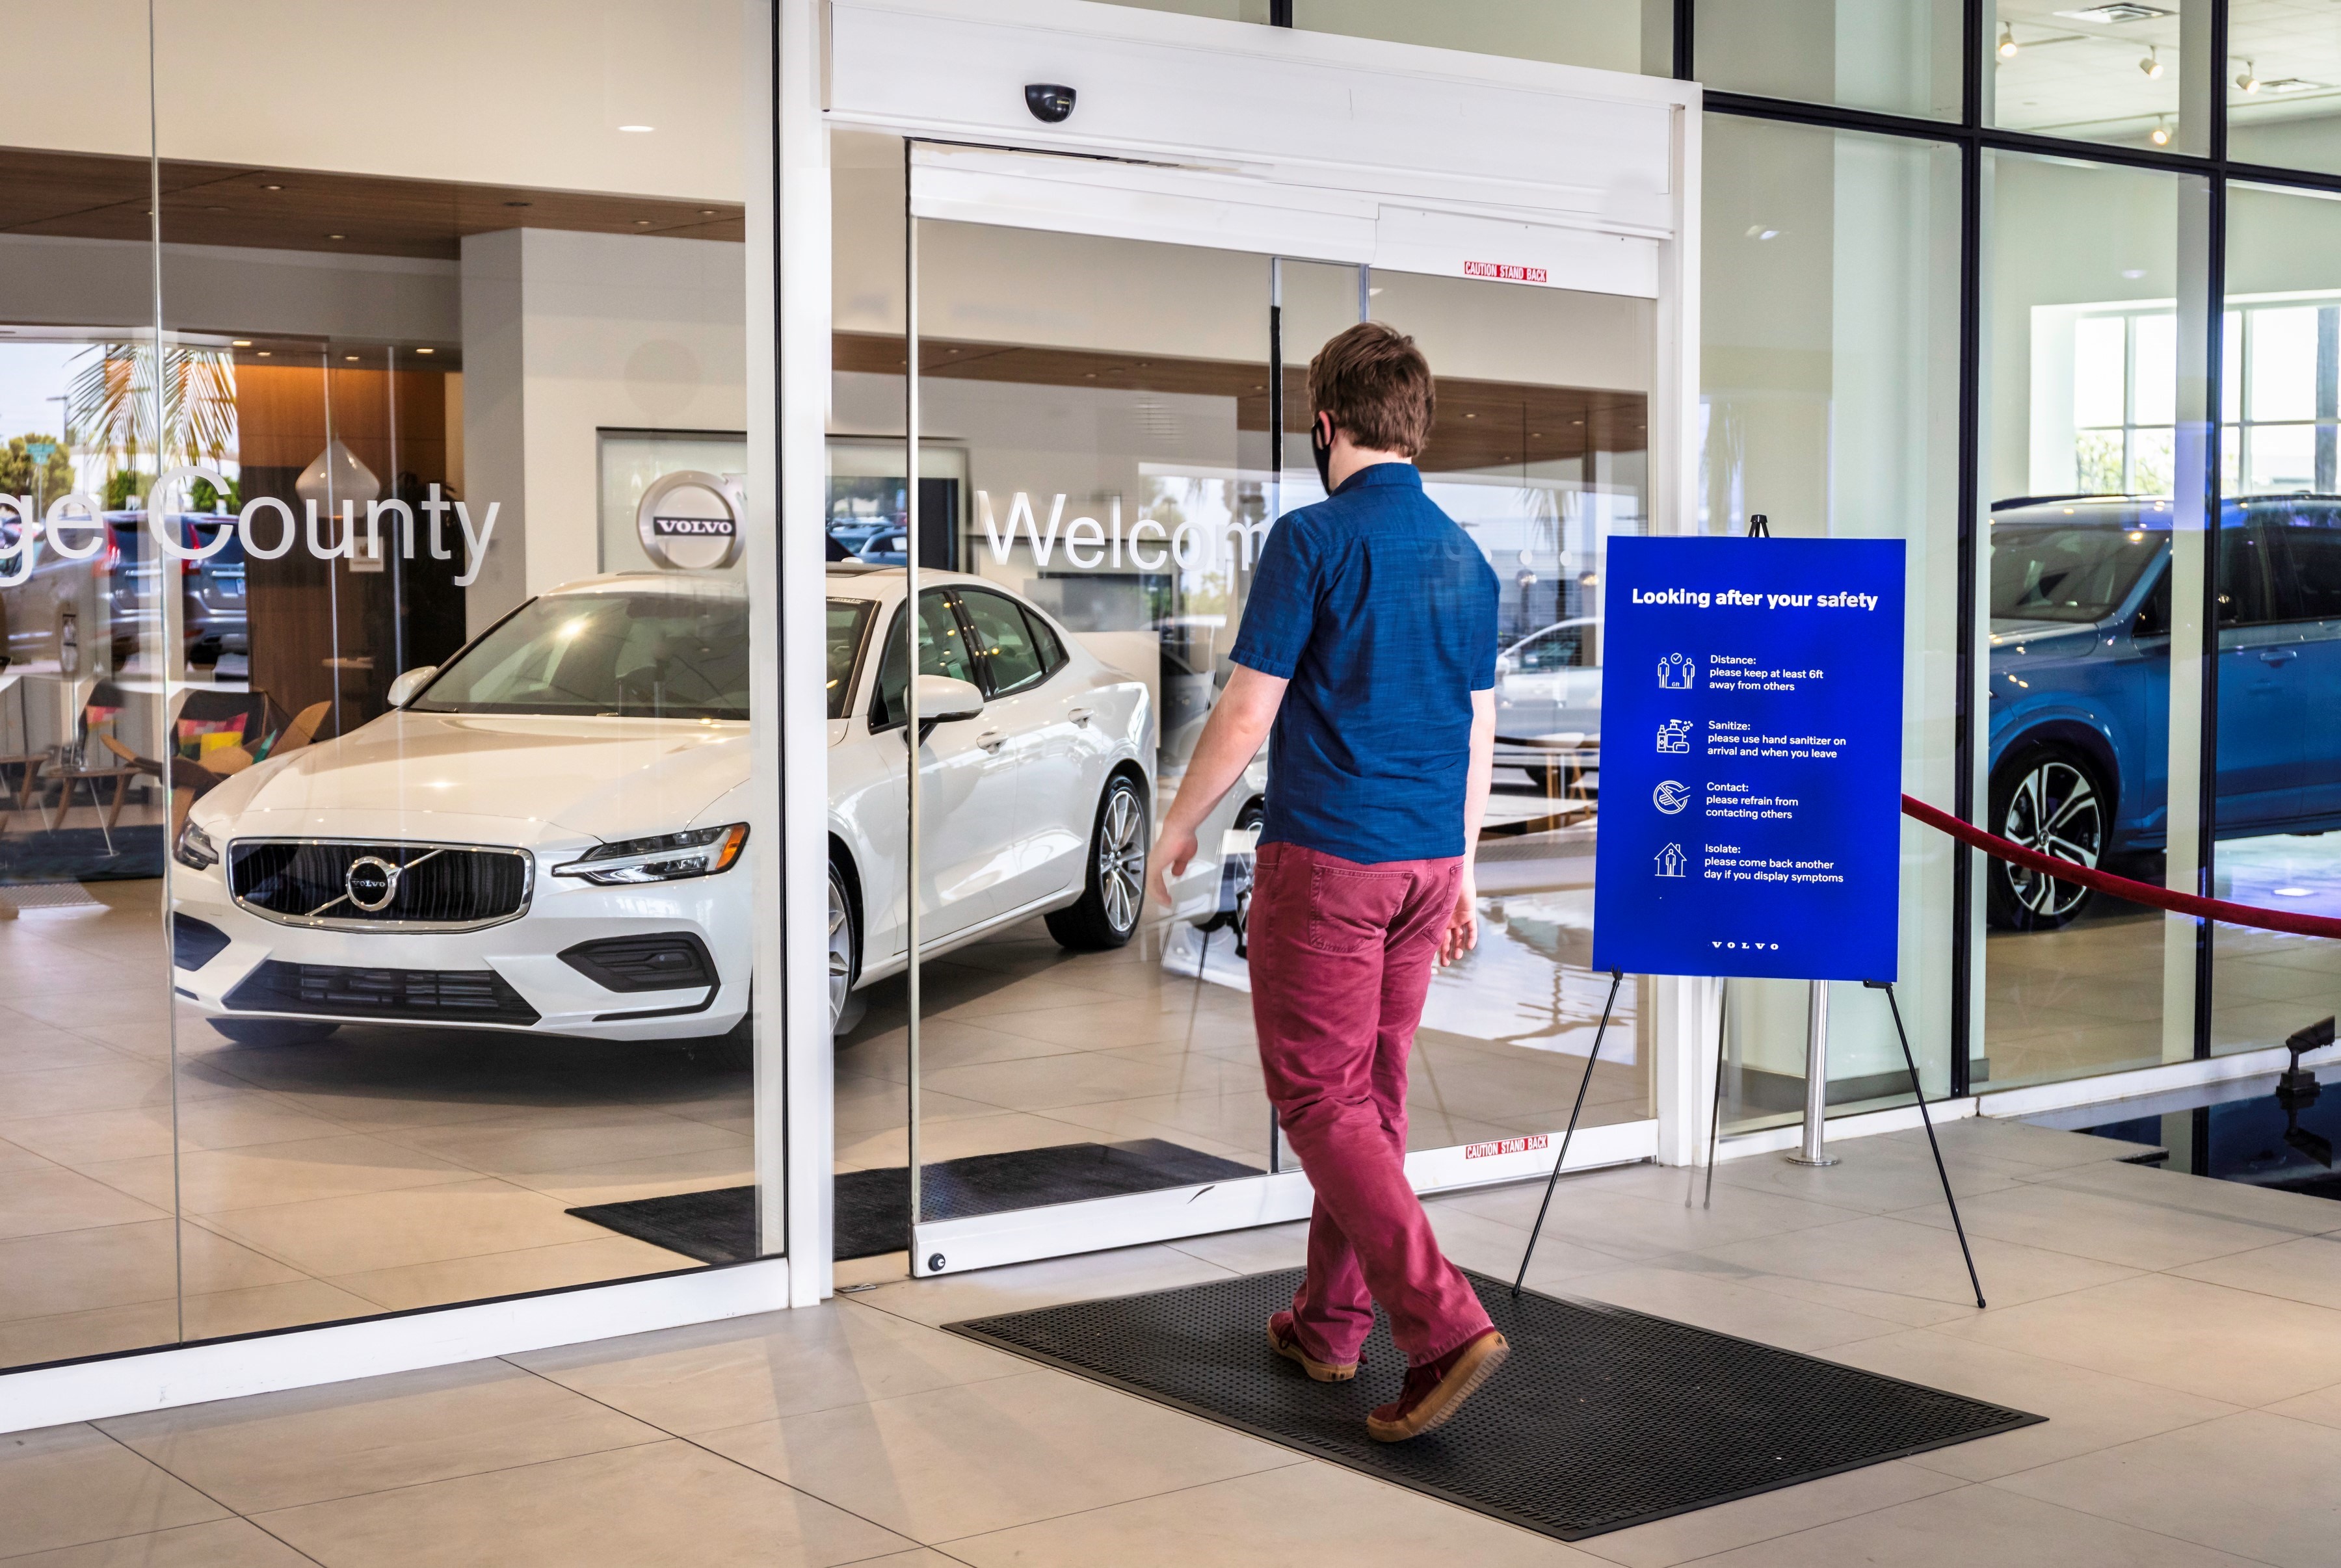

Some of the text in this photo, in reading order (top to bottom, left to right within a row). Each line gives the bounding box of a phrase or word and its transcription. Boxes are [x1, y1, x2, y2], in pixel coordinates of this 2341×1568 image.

[1466, 261, 1546, 282] CAUTION STAND BACK
[148, 466, 501, 586] County
[657, 519, 733, 534] VOLVO
[1633, 588, 1878, 610] Looking after your safety
[1711, 655, 1756, 664] Distance:
[1710, 668, 1741, 677] please
[1745, 668, 1767, 679] keep
[1783, 670, 1806, 678] least
[1809, 670, 1823, 679] 6ft
[1710, 681, 1795, 690] away from others
[1709, 721, 1750, 730] Sanitize:
[1708, 733, 1739, 744] please
[1763, 735, 1786, 744] hand
[1790, 736, 1831, 745] sanitizer
[1761, 748, 1788, 757] when
[1812, 749, 1837, 758] leave
[1707, 782, 1748, 792] Contact:
[1706, 795, 1798, 805] please refrain from
[1706, 809, 1792, 820] contacting others
[1706, 844, 1740, 853] Isolate:
[1705, 857, 1736, 867] please
[1769, 859, 1793, 868] back
[1795, 860, 1834, 869] another
[1704, 869, 1844, 883] day if you display symptoms
[1467, 1136, 1547, 1158] CAUTION STAND BACK
